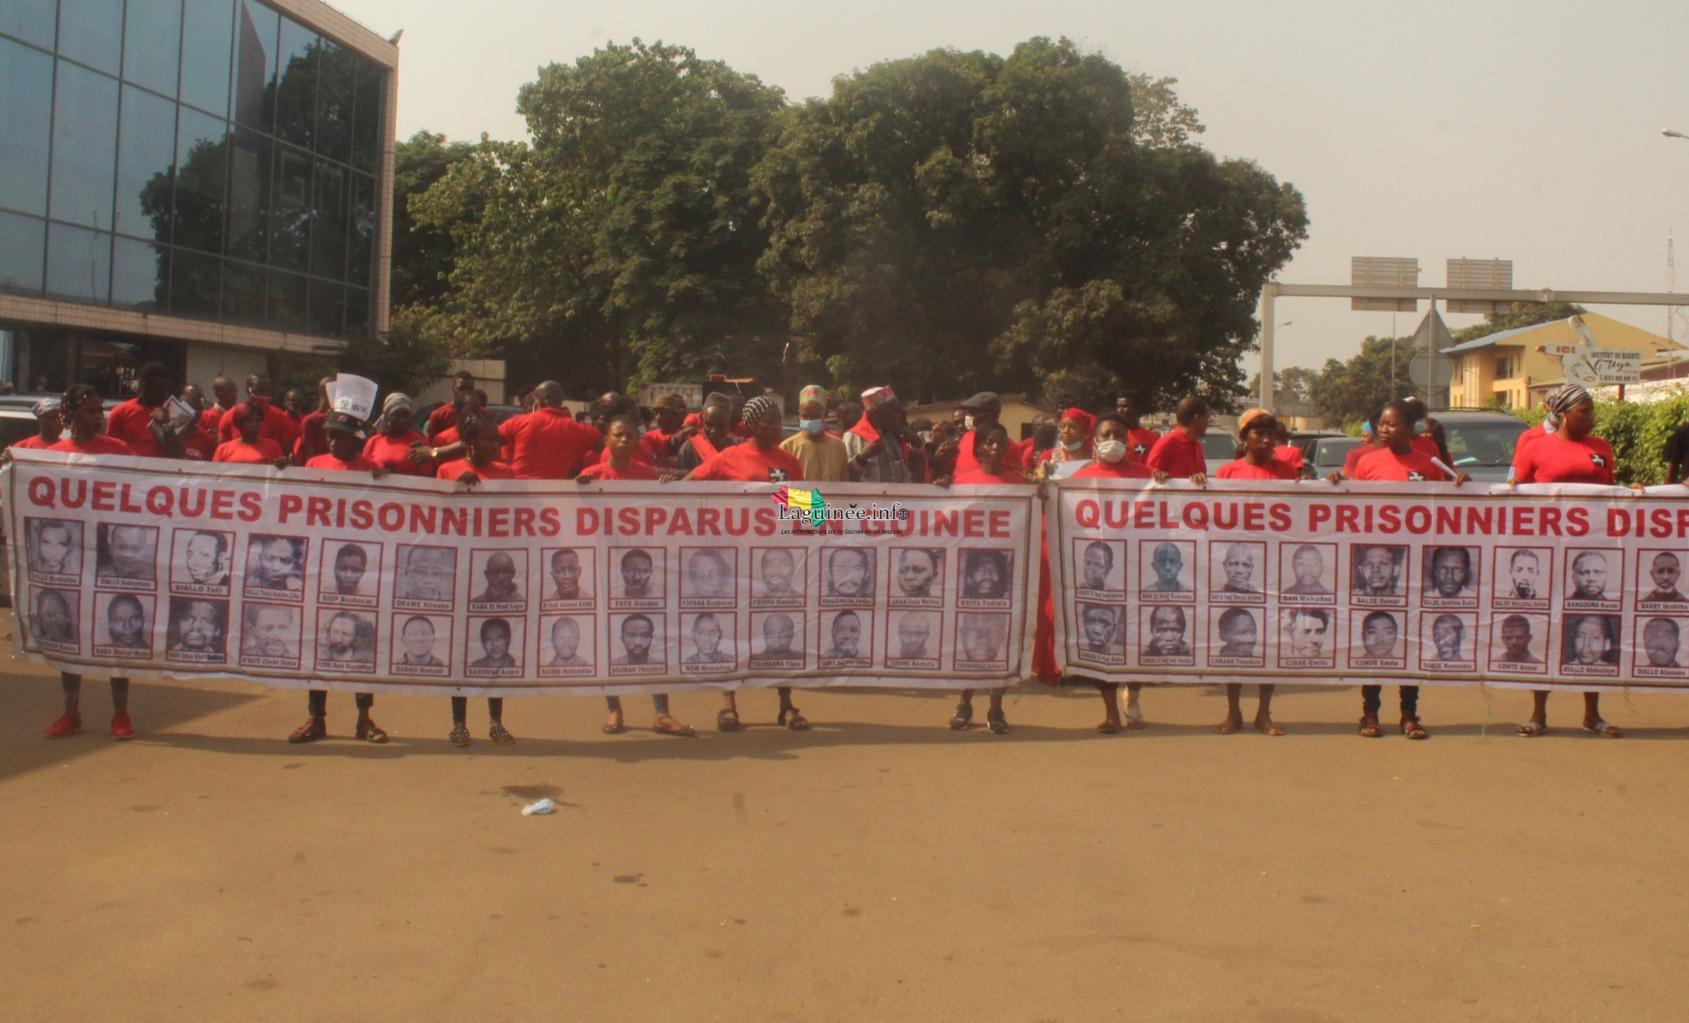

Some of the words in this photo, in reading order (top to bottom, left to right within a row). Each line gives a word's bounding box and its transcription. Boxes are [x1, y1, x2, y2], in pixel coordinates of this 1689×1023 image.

[28, 476, 262, 523] QUELQUES
[278, 494, 561, 537] PRISONNIERS
[576, 507, 776, 536] DISPARUS
[1075, 499, 1292, 532] QUELQUES
[1309, 504, 1589, 536] PRISONNIERS
[176, 584, 204, 592] DIALLO
